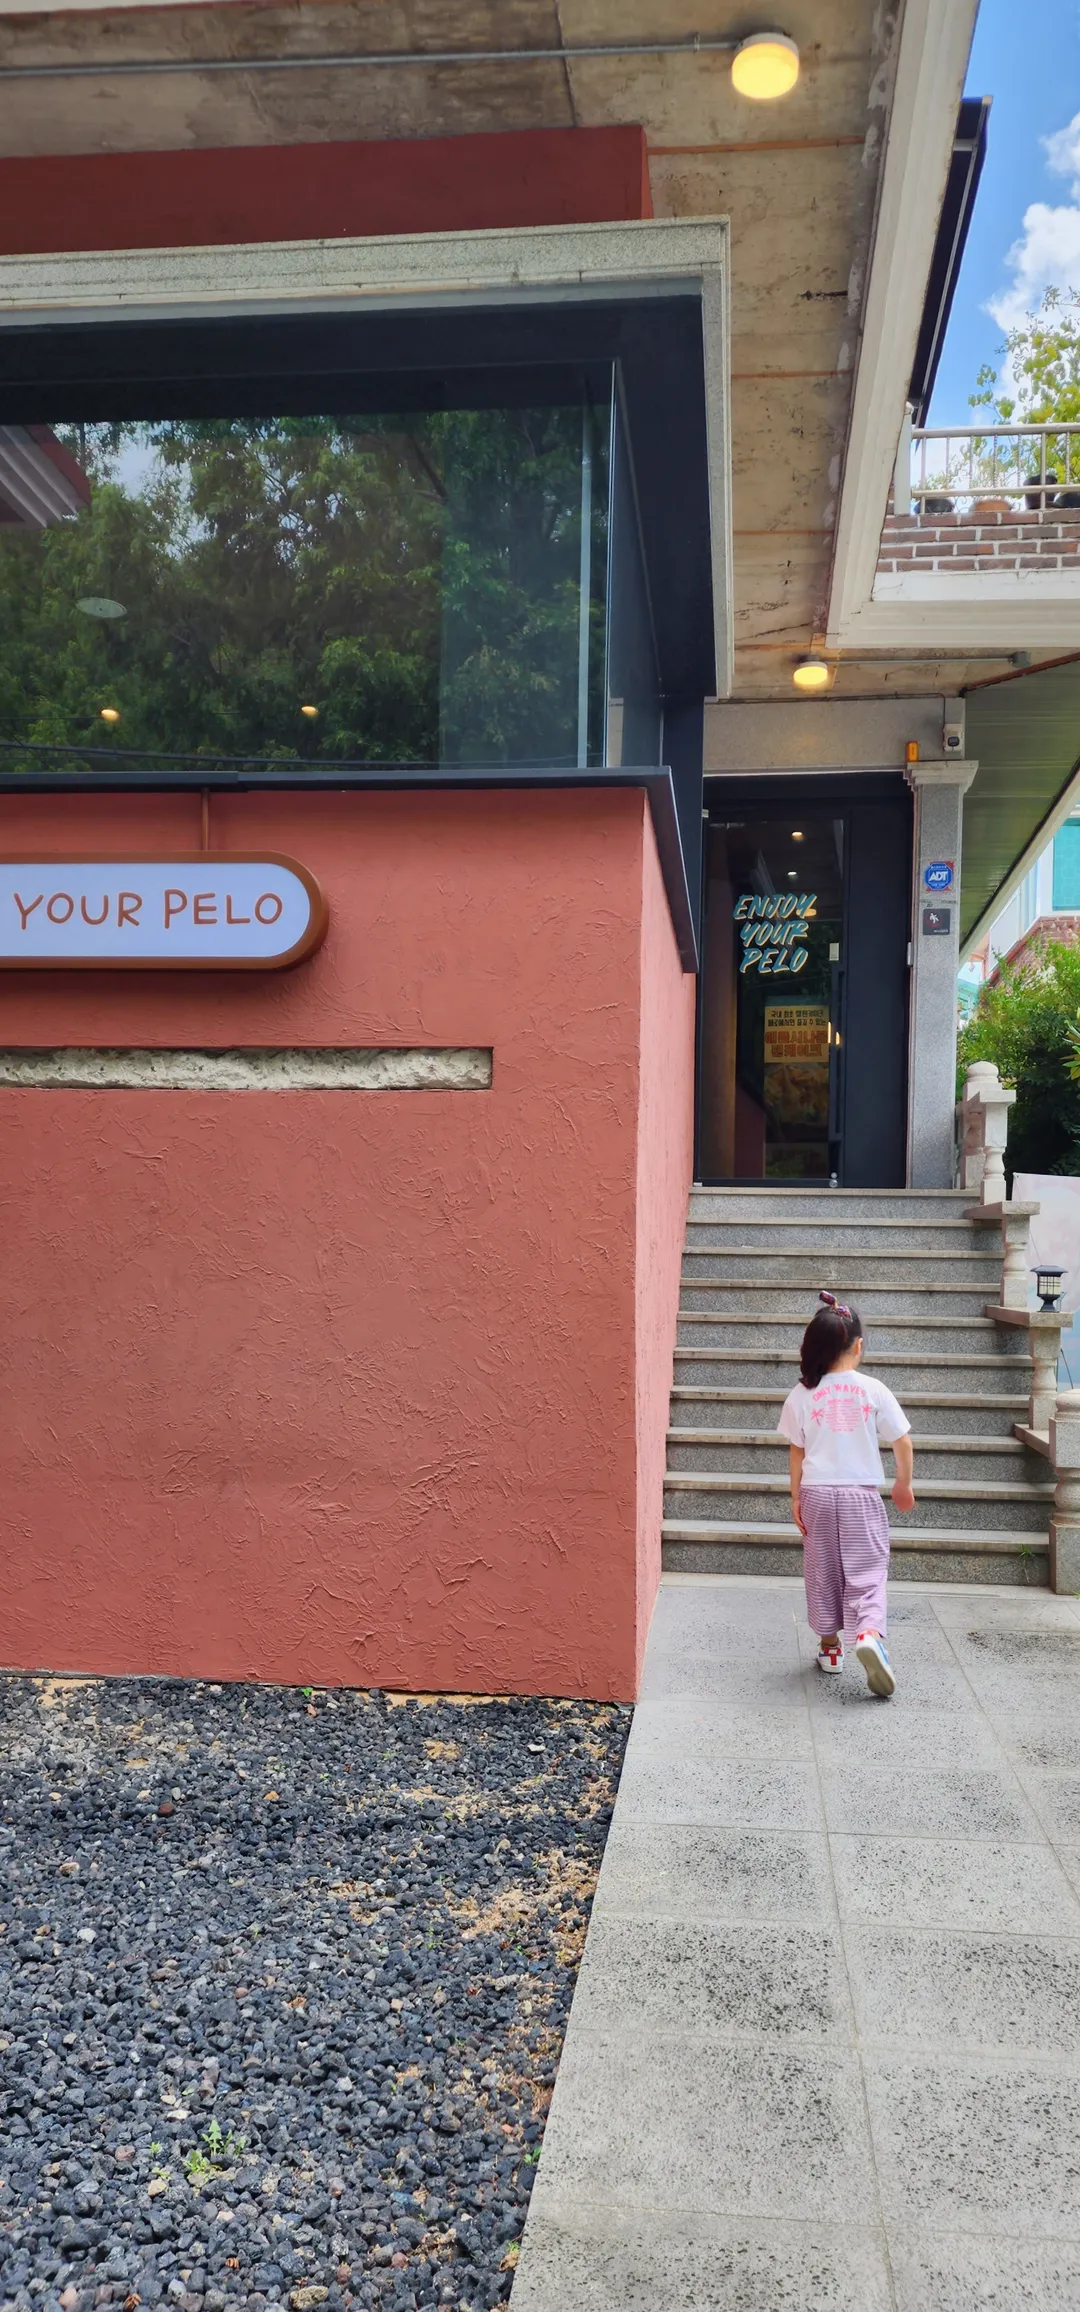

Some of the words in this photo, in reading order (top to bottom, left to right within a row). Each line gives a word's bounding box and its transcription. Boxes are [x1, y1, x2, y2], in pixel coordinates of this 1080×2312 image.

[928, 871, 948, 881] ADT
[13, 891, 143, 930] YOUR
[163, 888, 283, 929] PELO
[733, 893, 818, 919] ENJOY
[740, 920, 809, 947] YOUR
[739, 947, 808, 973] PELO
[812, 1386, 831, 1401] ONLY
[834, 1384, 866, 1397] WAVES
